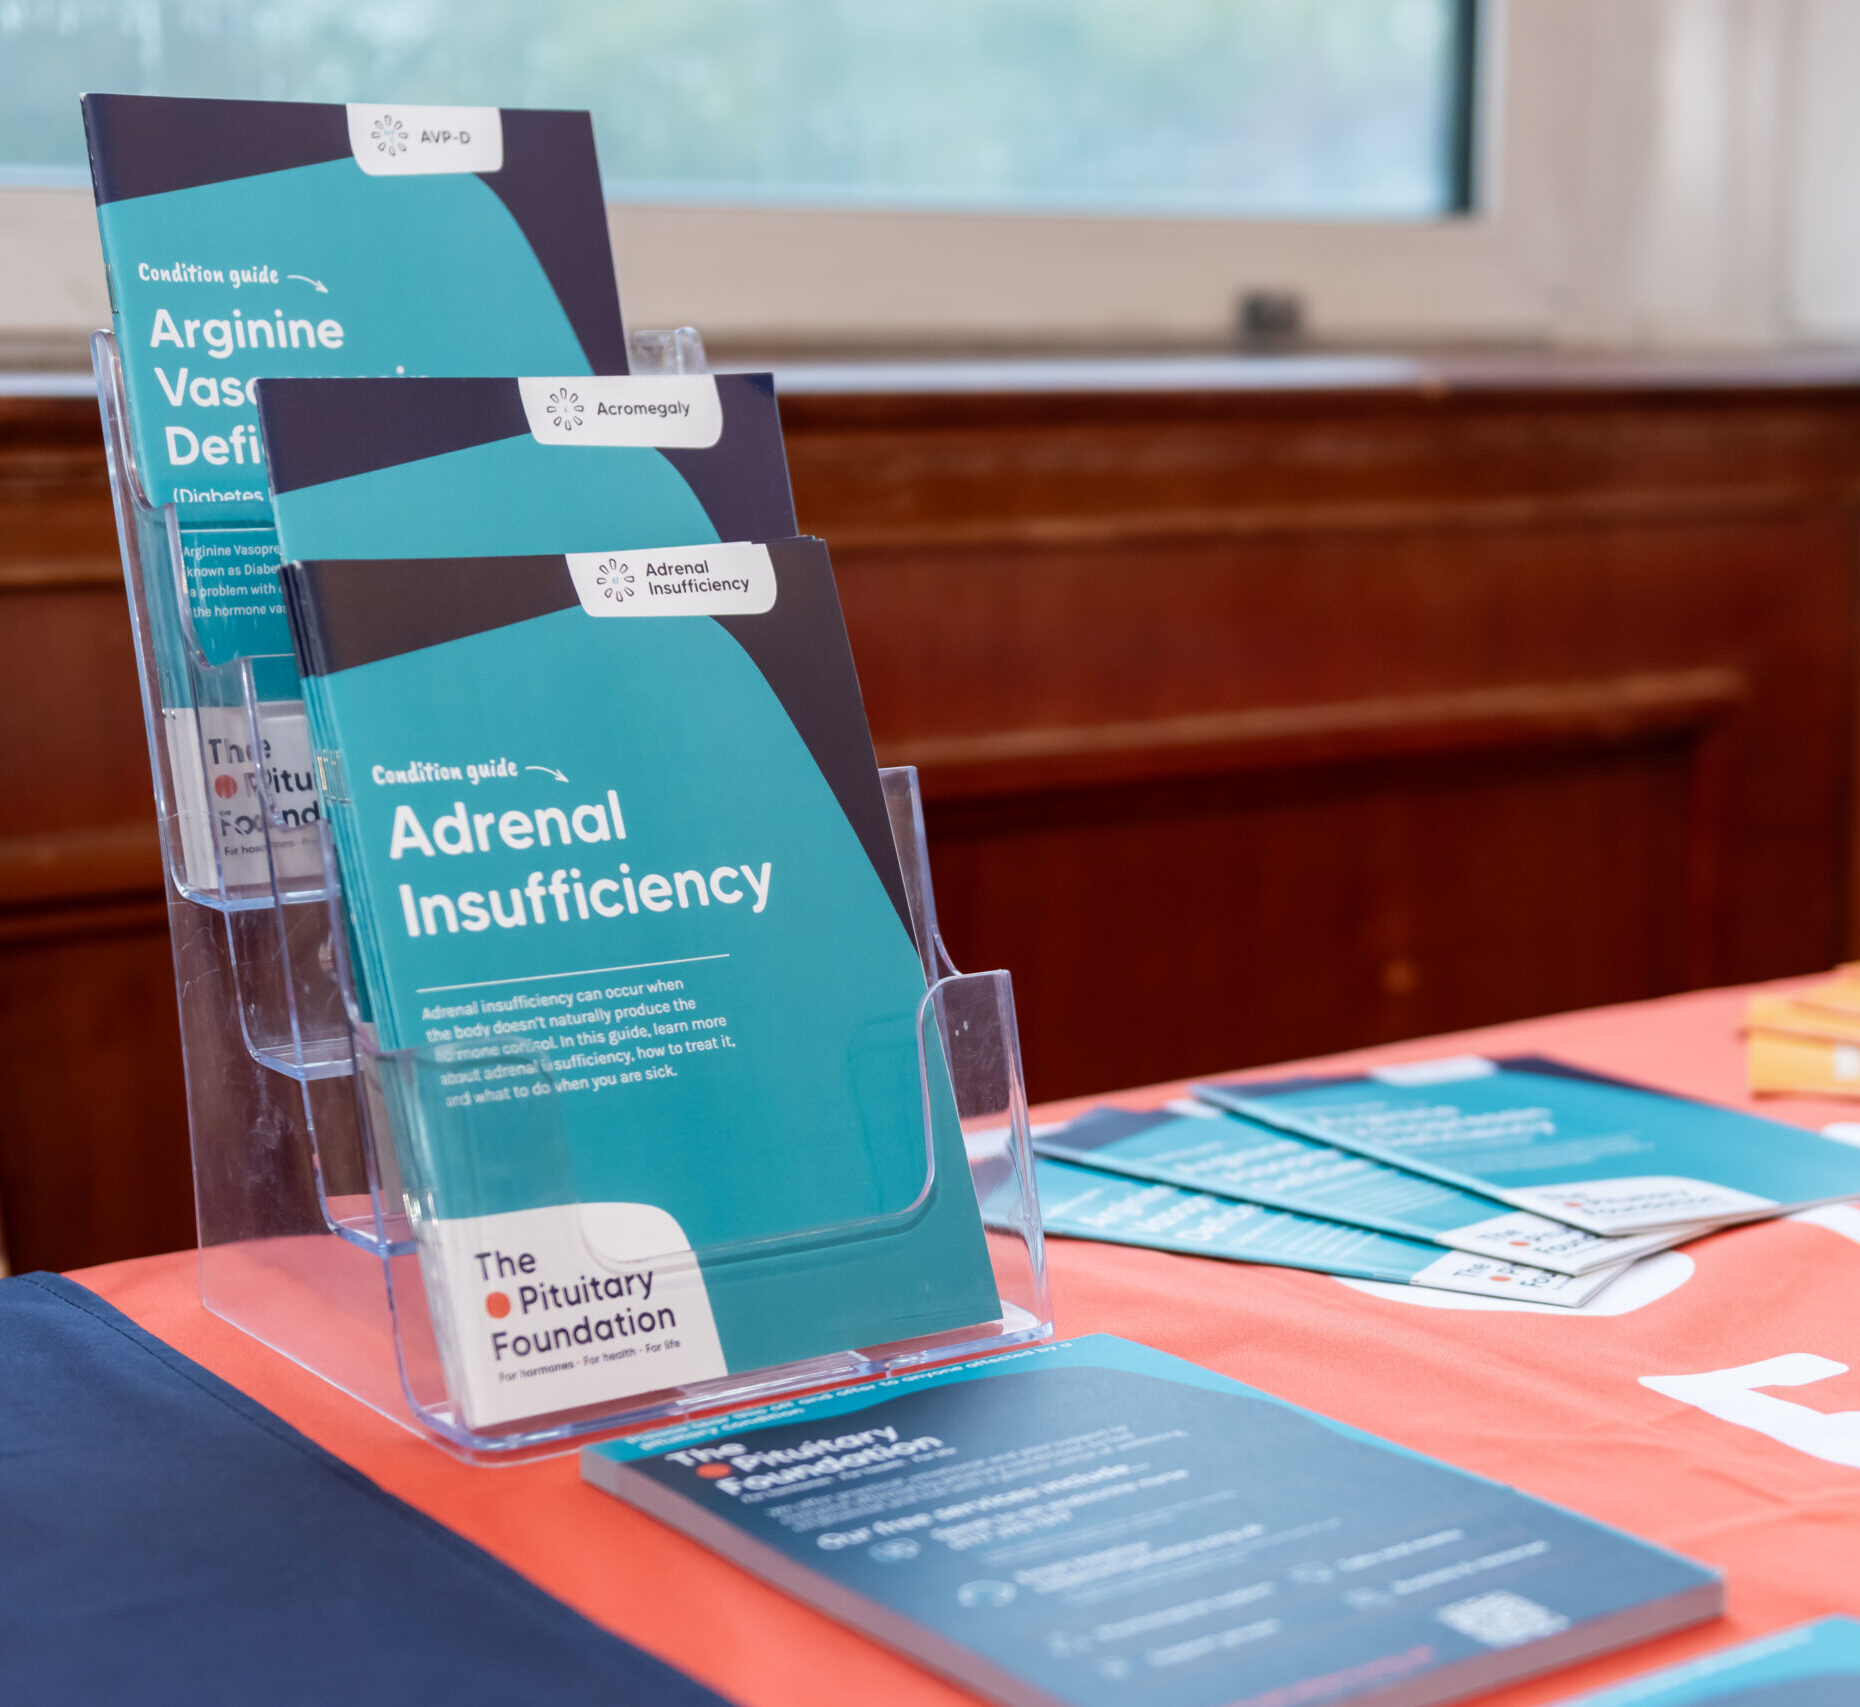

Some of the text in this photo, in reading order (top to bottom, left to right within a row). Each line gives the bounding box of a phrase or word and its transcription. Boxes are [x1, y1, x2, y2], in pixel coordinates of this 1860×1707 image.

[421, 130, 471, 145] AVP-D
[138, 262, 279, 289] Condition guide
[150, 308, 345, 360] Arginine
[597, 401, 691, 418] Acromegaly
[183, 545, 231, 561] Arginine
[186, 565, 225, 578] known
[228, 567, 242, 577] as
[646, 560, 710, 577] Adrenal
[189, 583, 276, 600] a problem with
[649, 578, 750, 596] Insufficiency
[192, 607, 212, 618] the
[214, 604, 266, 617] hormone
[371, 757, 519, 786] Condition guide
[389, 789, 627, 860] Adrenal
[399, 861, 772, 938] Insufficiency
[422, 978, 685, 1021] Adrenal insufficiency can occur when
[426, 997, 697, 1043] the body doesn't naturally produce the
[560, 1034, 575, 1049] In
[576, 1030, 606, 1047] this
[608, 1025, 652, 1047] guide,
[652, 1020, 689, 1036] learn
[691, 1015, 727, 1031] more
[484, 1059, 539, 1081] adrenal
[636, 1045, 666, 1061] how
[667, 1041, 684, 1056] to
[685, 1036, 719, 1052] treat
[720, 1033, 737, 1048] it,
[474, 1086, 512, 1104] what
[513, 1084, 530, 1099] to
[531, 1080, 551, 1096] do
[590, 1074, 618, 1093] you
[619, 1070, 643, 1085] are
[645, 1063, 679, 1081] sick.
[474, 1249, 537, 1281] The
[518, 1270, 654, 1315] Pituitary
[490, 1306, 677, 1362] Foundation
[498, 1337, 681, 1383] For hormones For health For life
[878, 1375, 899, 1388] to
[900, 1364, 964, 1384] anyone
[965, 1349, 1035, 1370] affected
[1036, 1344, 1058, 1356] by
[664, 1442, 749, 1468] The
[714, 1435, 945, 1498] Foundation
[729, 1425, 900, 1473] Pituitary
